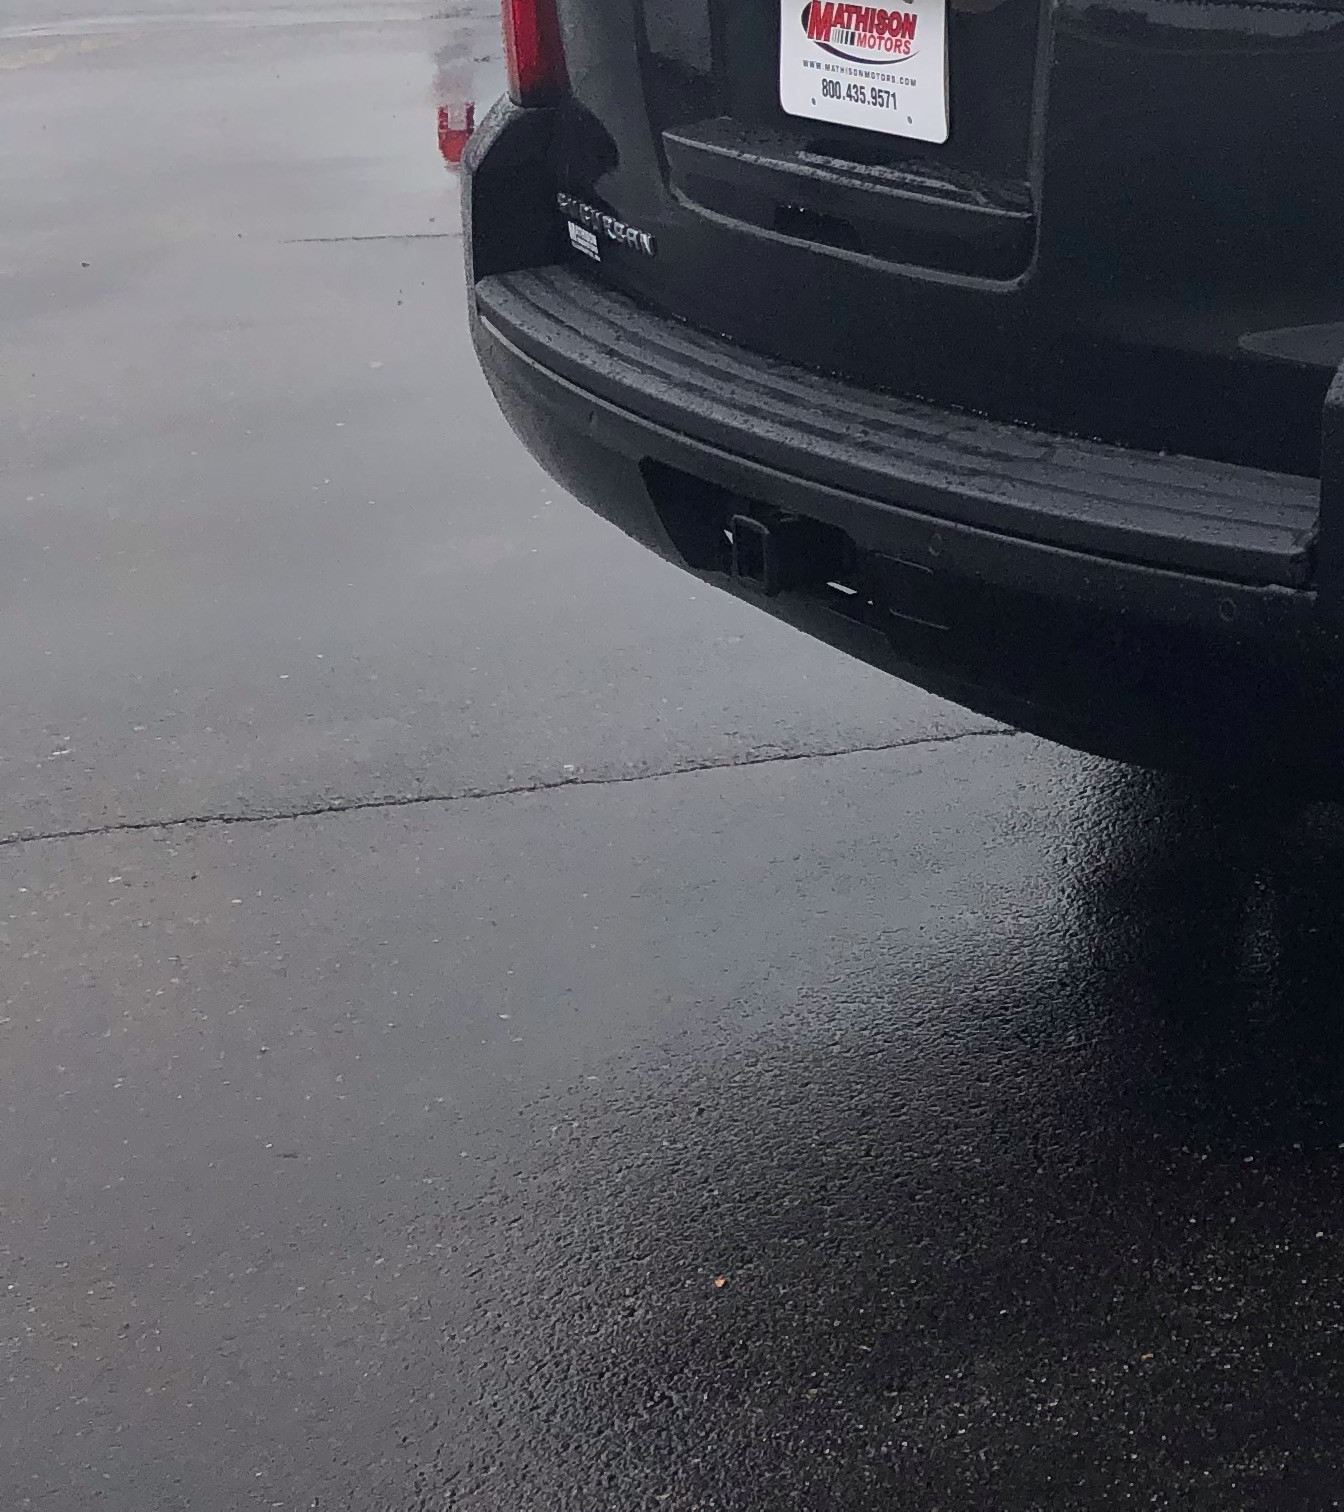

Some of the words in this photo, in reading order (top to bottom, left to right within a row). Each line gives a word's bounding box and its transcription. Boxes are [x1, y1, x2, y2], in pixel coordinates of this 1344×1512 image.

[807, 0, 918, 42] MATHISON
[856, 32, 912, 55] MOTORS
[821, 78, 897, 110] 800.435.9571
